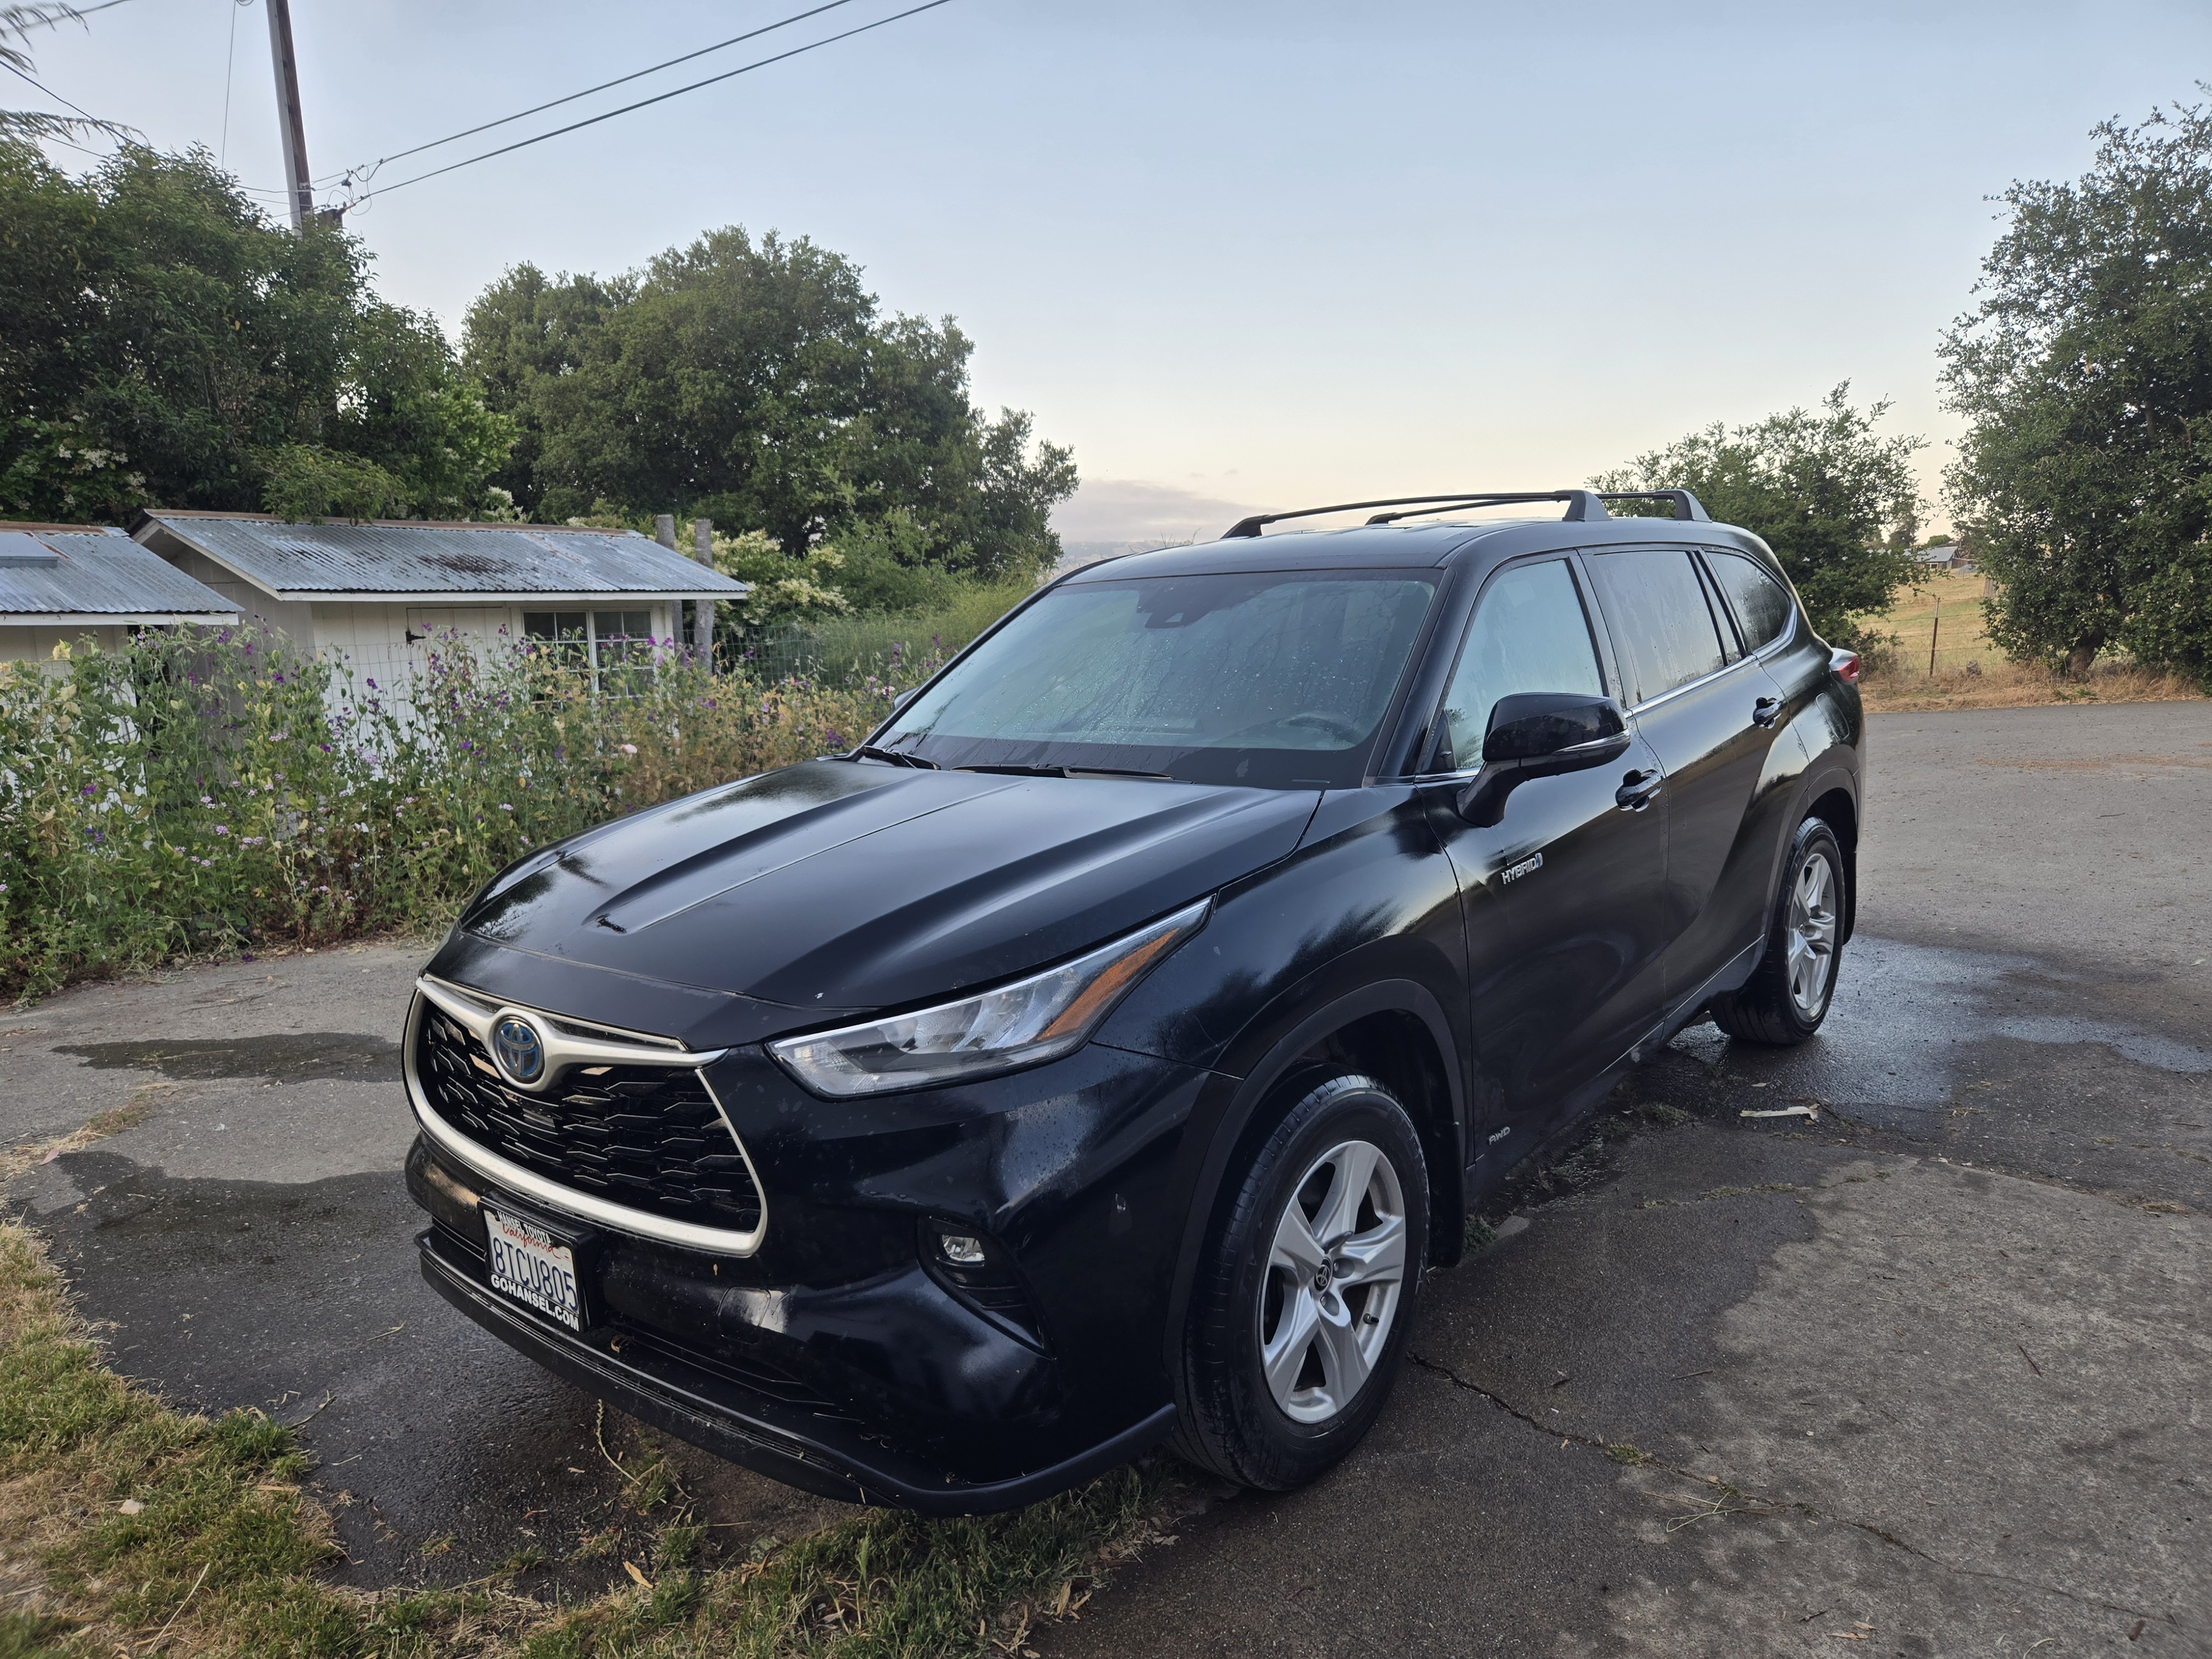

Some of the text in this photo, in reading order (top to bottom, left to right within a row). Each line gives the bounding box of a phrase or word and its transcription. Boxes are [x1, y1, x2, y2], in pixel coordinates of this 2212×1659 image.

[1501, 857, 1537, 884] HYBRID
[1488, 1126, 1510, 1145] AWD
[497, 1211, 551, 1245] HANSEL TOYOTA
[493, 1237, 580, 1312] 8TCU805
[491, 1274, 580, 1332] GOHANSEL.COM
